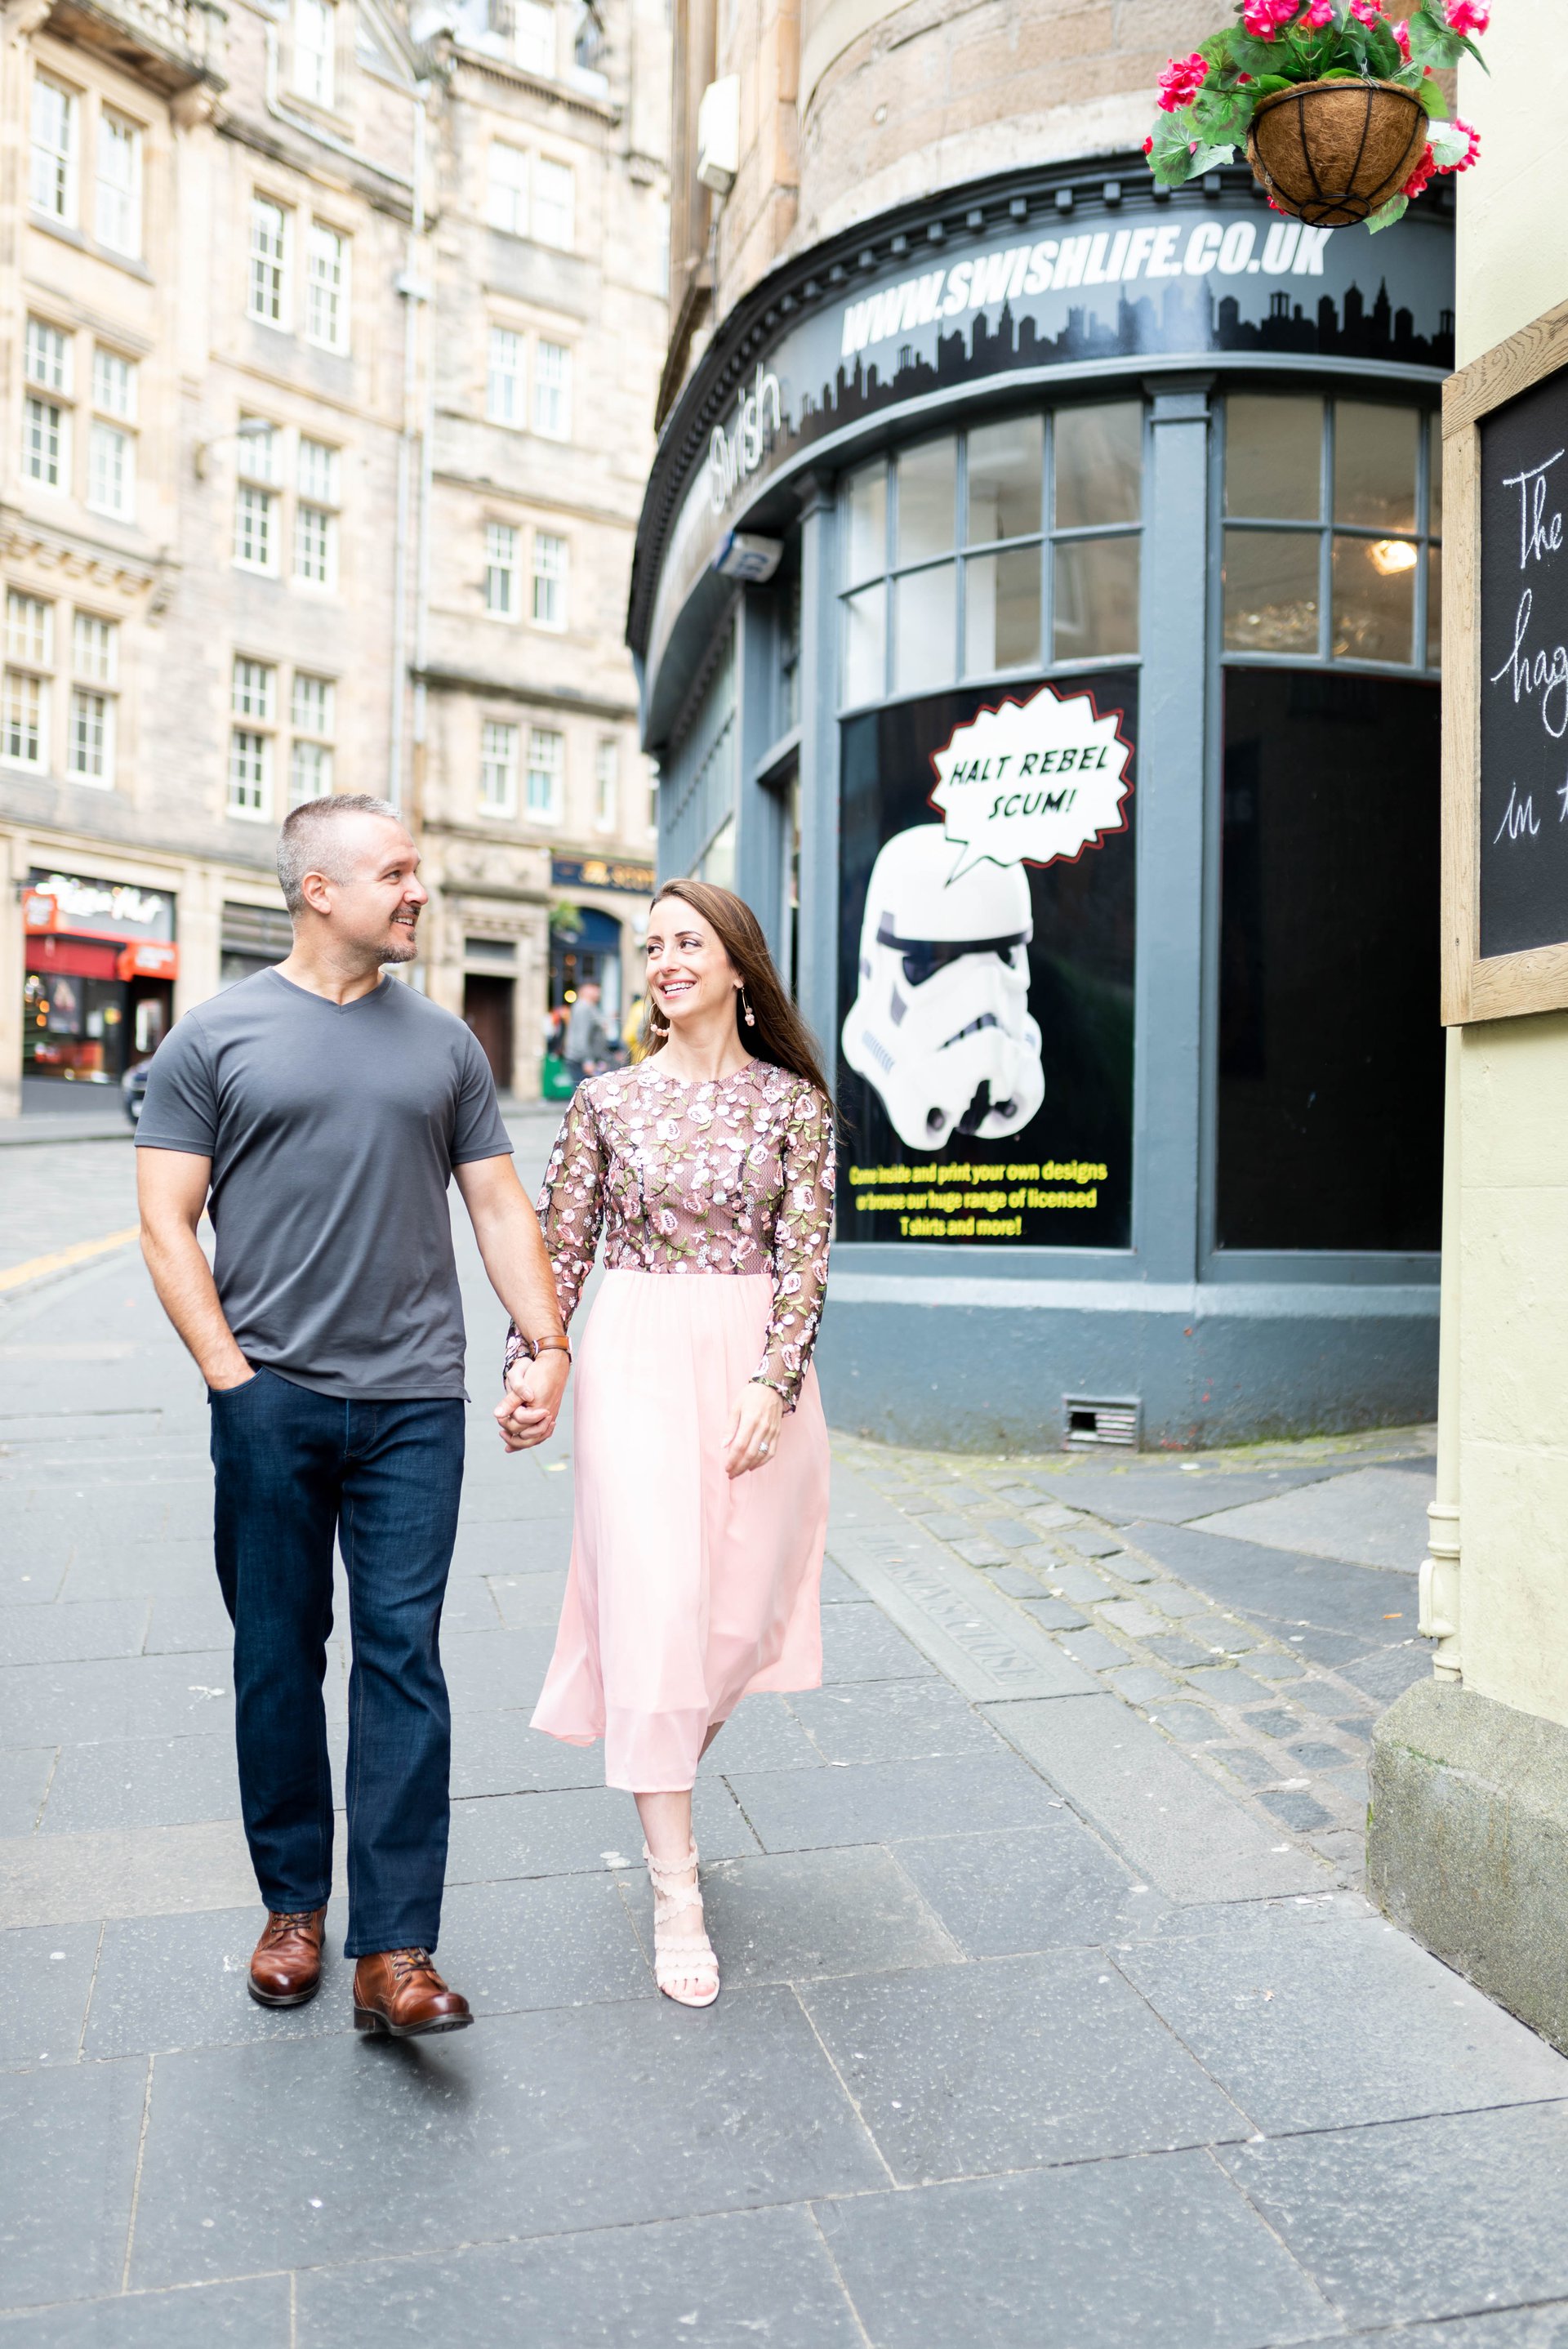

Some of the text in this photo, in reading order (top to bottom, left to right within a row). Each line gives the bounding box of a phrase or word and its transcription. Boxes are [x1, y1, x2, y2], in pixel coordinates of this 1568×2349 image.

[841, 221, 1334, 358] WWW.SWISHLIFE.CO.UK
[710, 363, 781, 515] Swish
[1503, 448, 1565, 568] The
[950, 746, 1109, 787] HALT REBEL
[989, 789, 1077, 820] SCUM!
[1493, 781, 1541, 845] in
[849, 1159, 1108, 1186] Come inside and print your own designs
[906, 1193, 928, 1210] our
[928, 1189, 962, 1213] huge
[964, 1191, 1007, 1213] range
[1008, 1187, 1027, 1209] of
[1027, 1188, 1098, 1209] licensed
[947, 1215, 975, 1237] and
[976, 1215, 1022, 1237] more!
